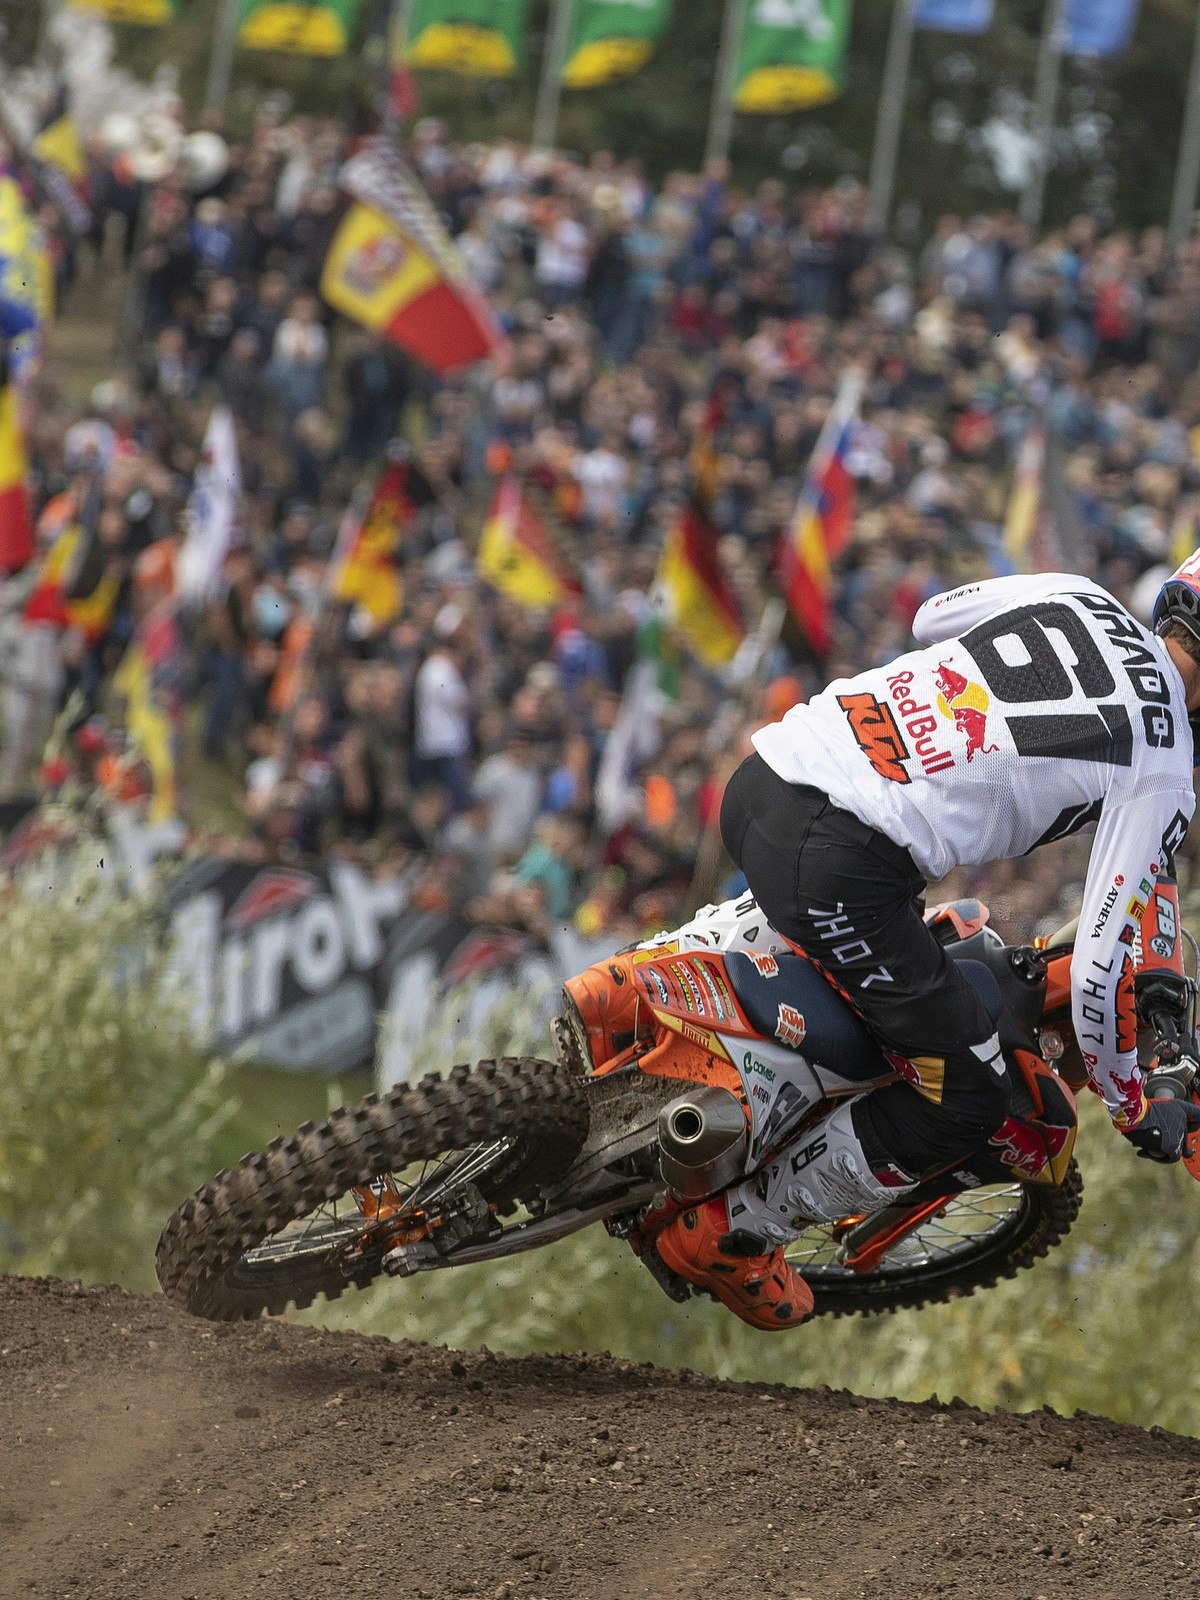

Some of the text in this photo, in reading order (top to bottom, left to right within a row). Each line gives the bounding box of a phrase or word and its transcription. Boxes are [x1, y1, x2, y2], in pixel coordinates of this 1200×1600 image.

[958, 601, 1132, 766] 61
[835, 693, 911, 784] KTM
[888, 671, 955, 774] Red Bull
[1091, 886, 1119, 938] ATHENA
[685, 970, 704, 1014] ATHENA
[753, 1060, 777, 1083] COMSA
